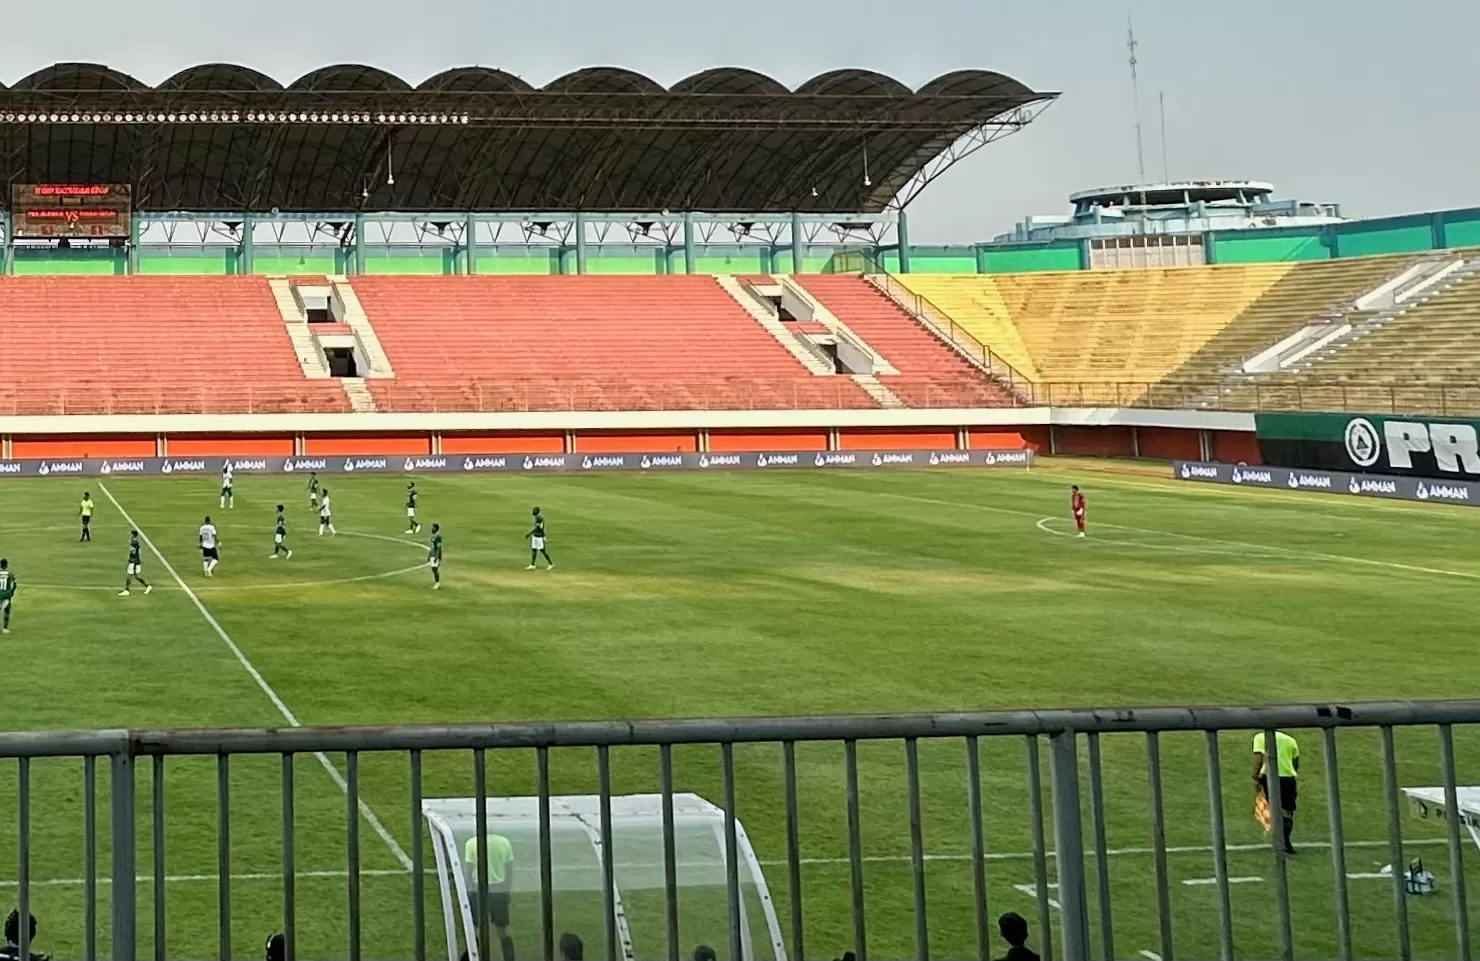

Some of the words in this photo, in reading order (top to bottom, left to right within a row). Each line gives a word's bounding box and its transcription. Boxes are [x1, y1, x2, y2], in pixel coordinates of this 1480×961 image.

[65, 210, 79, 222] VS
[474, 457, 506, 468] AMMAN
[534, 456, 565, 467] AMMAN
[593, 456, 624, 467] AMMAN
[652, 455, 682, 466] AMMAN
[710, 455, 741, 465] AMMAN
[769, 454, 798, 465] AMMAN
[826, 453, 856, 464] AMMAN
[883, 453, 913, 464] AMMAN
[941, 452, 970, 463] AMMAN
[997, 452, 1026, 462] AMMAN
[50, 461, 83, 472] AMMAN
[112, 461, 144, 471] AMMAN
[173, 460, 205, 471] AMMAN
[234, 459, 266, 470] AMMAN
[294, 459, 326, 470] AMMAN
[355, 459, 387, 469] AMMAN
[415, 458, 447, 468] AMMAN
[1191, 466, 1218, 478] AMMAN
[1242, 470, 1271, 483] AMMAN
[1299, 474, 1331, 488] AMMAN
[1361, 479, 1396, 493] AMMAN
[1429, 485, 1468, 500] AMMAN
